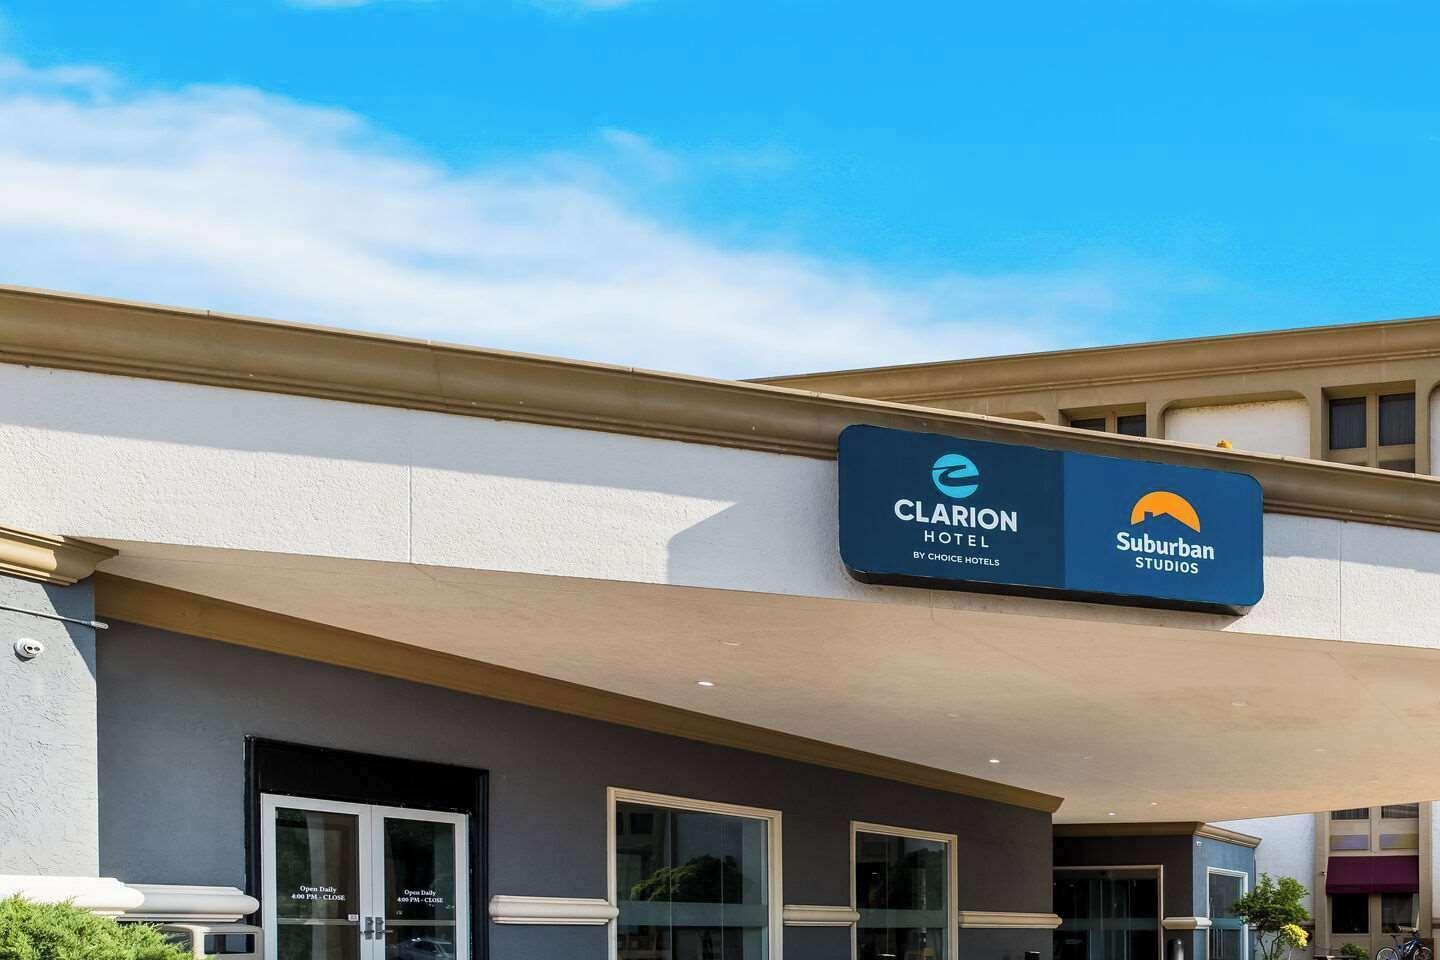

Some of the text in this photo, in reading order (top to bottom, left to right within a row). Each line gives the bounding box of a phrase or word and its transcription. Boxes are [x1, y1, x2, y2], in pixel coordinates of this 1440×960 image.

[894, 498, 1018, 533] CLARION
[924, 529, 990, 549] HOTEL
[1116, 531, 1215, 560] Suburban
[913, 551, 1000, 567] BY CHOICE HOTELS
[1135, 556, 1199, 574] STUDIOS
[300, 885, 337, 894] Open Daily
